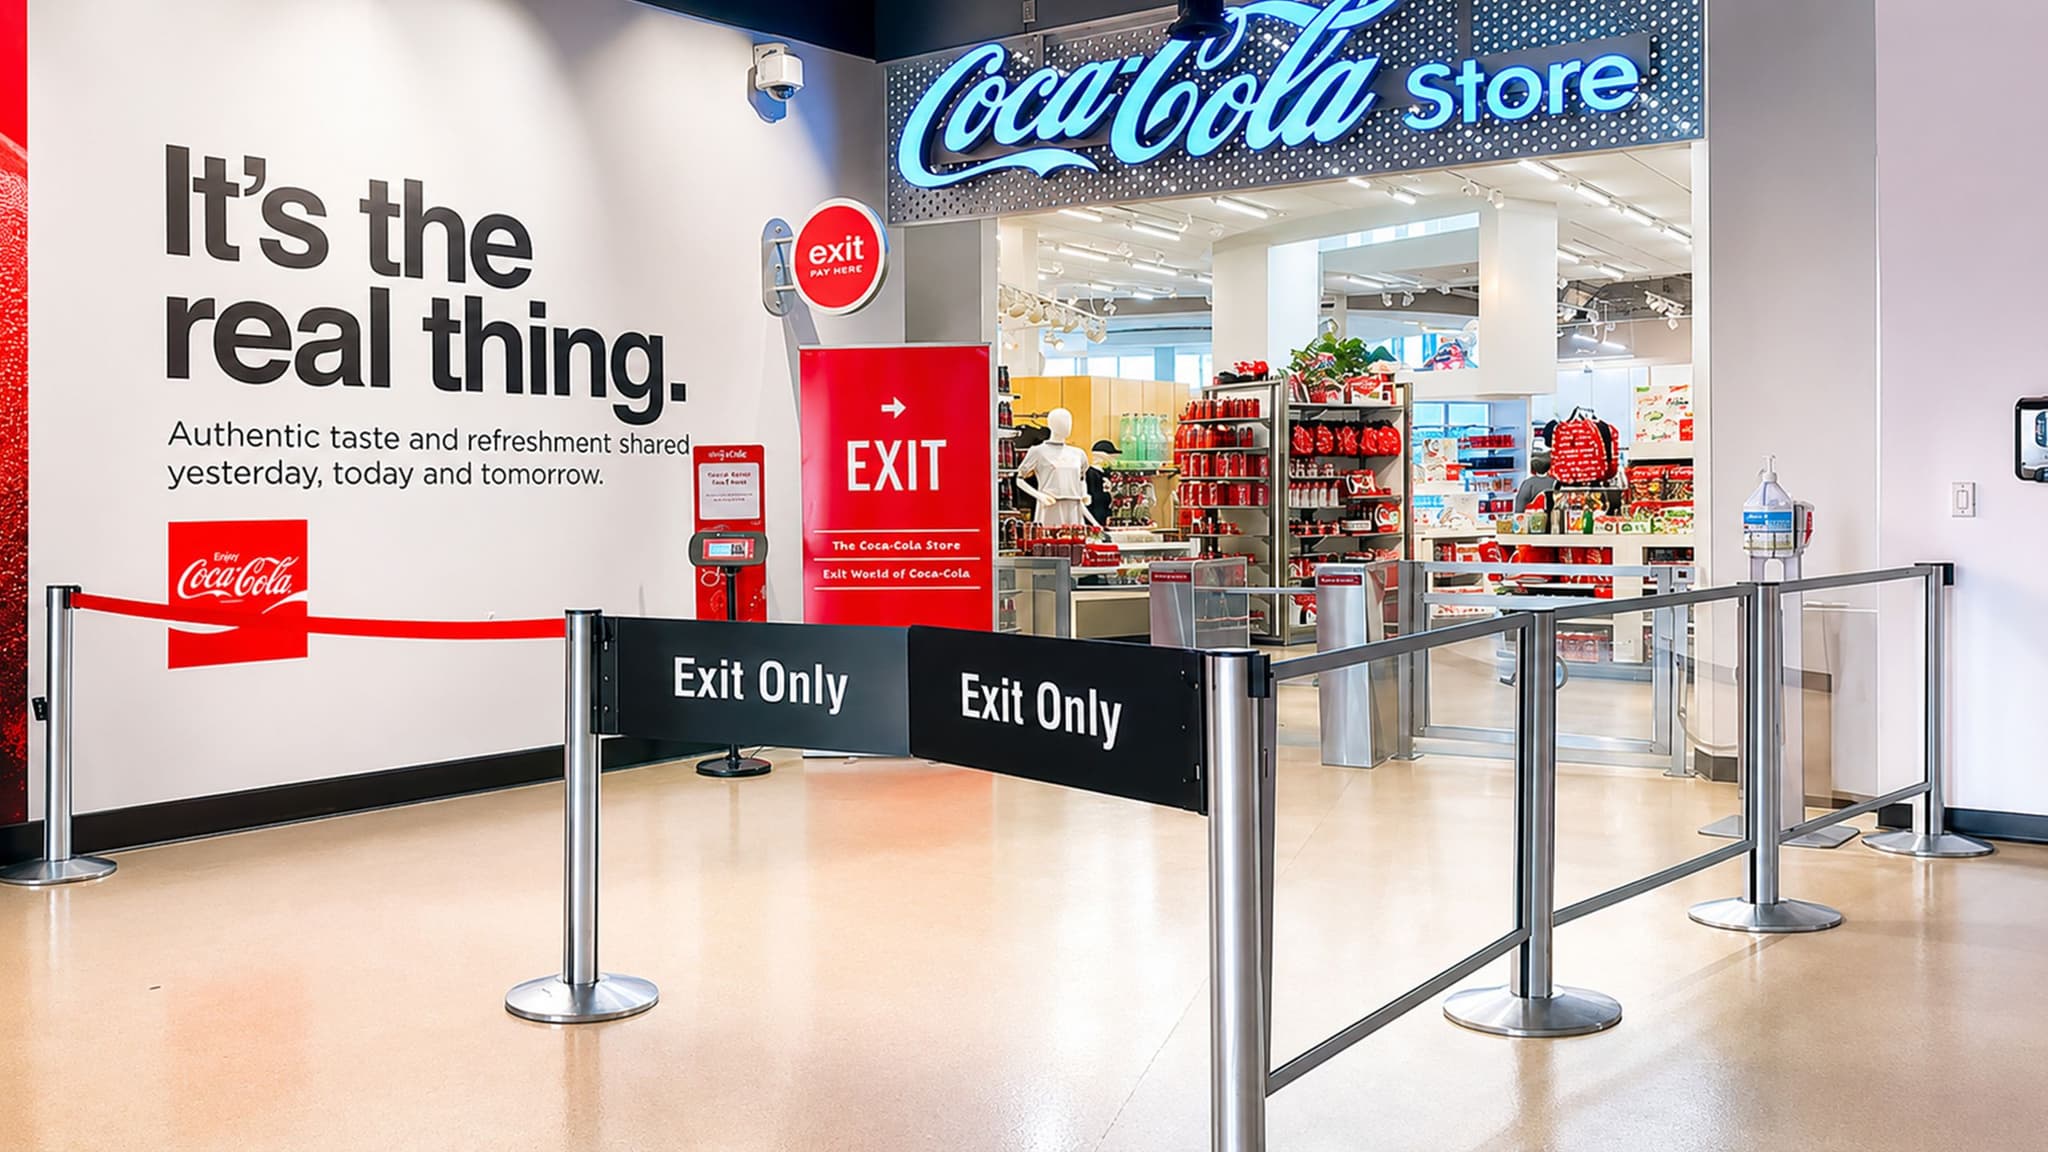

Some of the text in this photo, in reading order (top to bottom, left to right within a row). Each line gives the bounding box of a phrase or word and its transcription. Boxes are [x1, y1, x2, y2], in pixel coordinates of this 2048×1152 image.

[898, 0, 1639, 188] Coca-Cola Store
[165, 143, 534, 290] It’s the
[808, 233, 866, 266] exit
[809, 264, 863, 278] PAY HERE
[166, 286, 688, 426] real thing.
[167, 420, 690, 455] Authentic taste and refreshment shared
[167, 459, 605, 490] yesterday, today and tomorrow.
[847, 439, 947, 492] EXIT
[212, 551, 241, 564] Enjoy
[832, 540, 961, 551] The Coca-Cola Store
[176, 555, 300, 600] Coca-Cola
[823, 568, 971, 579] Exit World of Coca-Cola
[674, 656, 849, 716] Exit Only
[961, 672, 1122, 751] Exit Only
